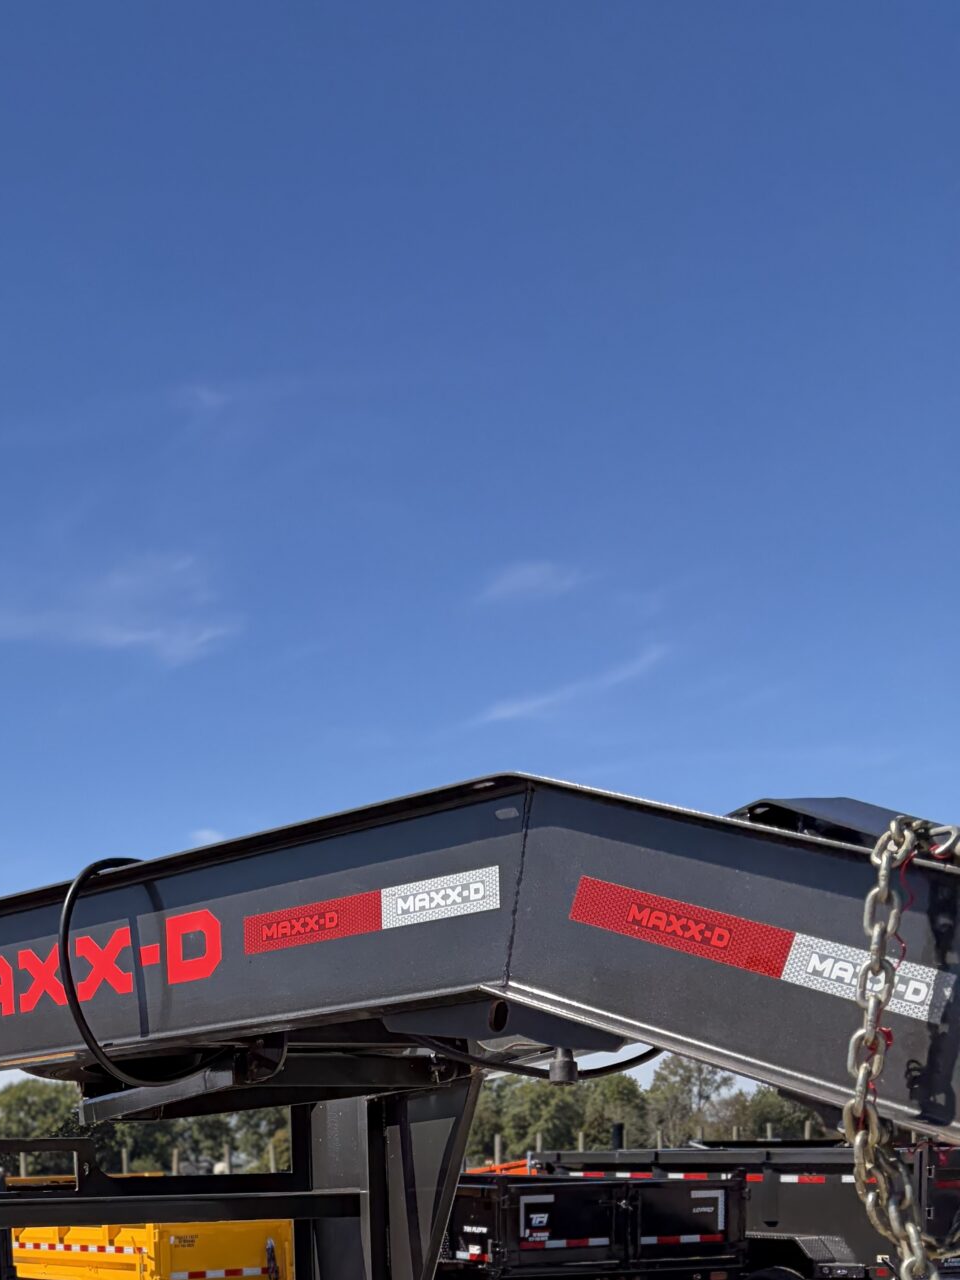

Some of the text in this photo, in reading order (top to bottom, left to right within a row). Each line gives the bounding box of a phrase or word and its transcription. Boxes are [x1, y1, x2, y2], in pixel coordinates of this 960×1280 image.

[396, 882, 485, 915] MAXX-D
[262, 911, 338, 941] MAXX-D
[628, 903, 732, 948] MAXX-D
